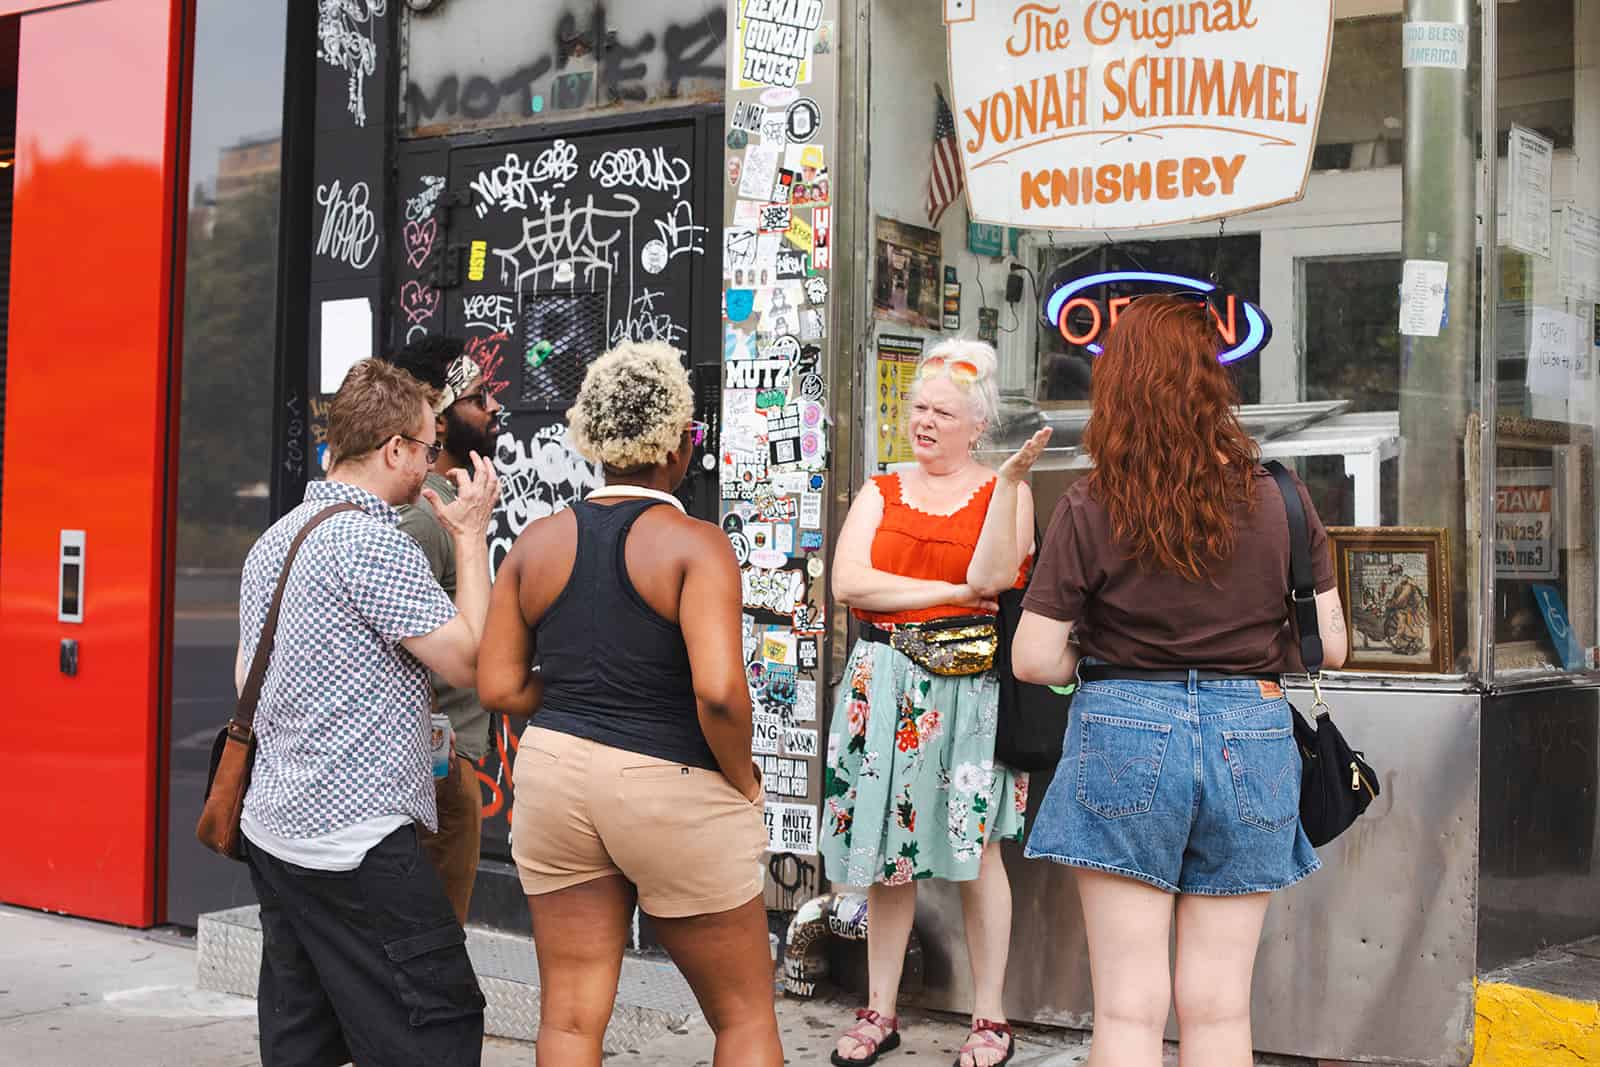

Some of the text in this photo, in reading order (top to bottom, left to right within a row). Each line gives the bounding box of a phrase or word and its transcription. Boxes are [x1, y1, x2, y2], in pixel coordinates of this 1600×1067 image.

[1006, 0, 1259, 57] The Original
[963, 54, 1308, 154] YONAH SCHIMMEL
[1020, 154, 1247, 210] KNISHERY
[1058, 293, 1238, 346] ON
[726, 360, 790, 389] MUTZ
[782, 814, 812, 830] MUTZ
[782, 828, 812, 844] CTONE
